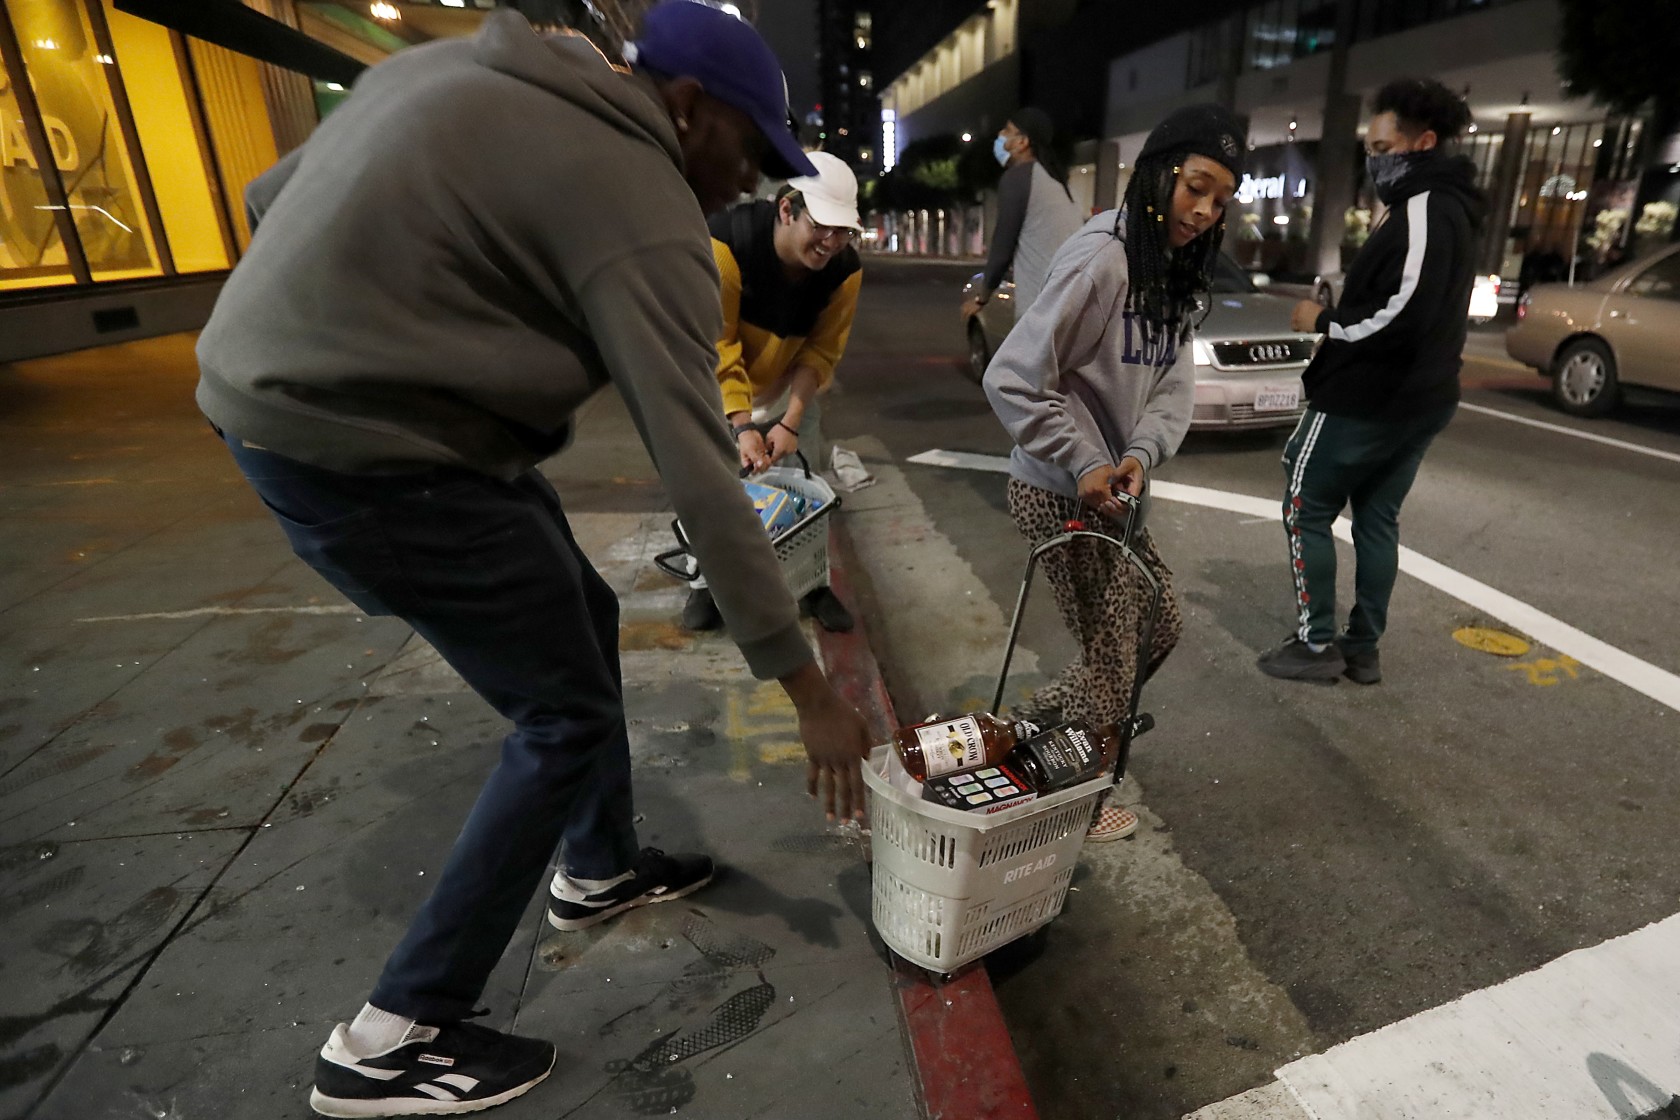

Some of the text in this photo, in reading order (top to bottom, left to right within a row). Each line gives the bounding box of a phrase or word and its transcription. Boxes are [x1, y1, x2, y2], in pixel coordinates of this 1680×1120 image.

[960, 722, 979, 761] OLD CROW
[1048, 740, 1068, 769] KENTUCKY
[1064, 726, 1090, 765] Williams
[1075, 729, 1093, 753] Evan
[1003, 853, 1057, 885] RITE AID
